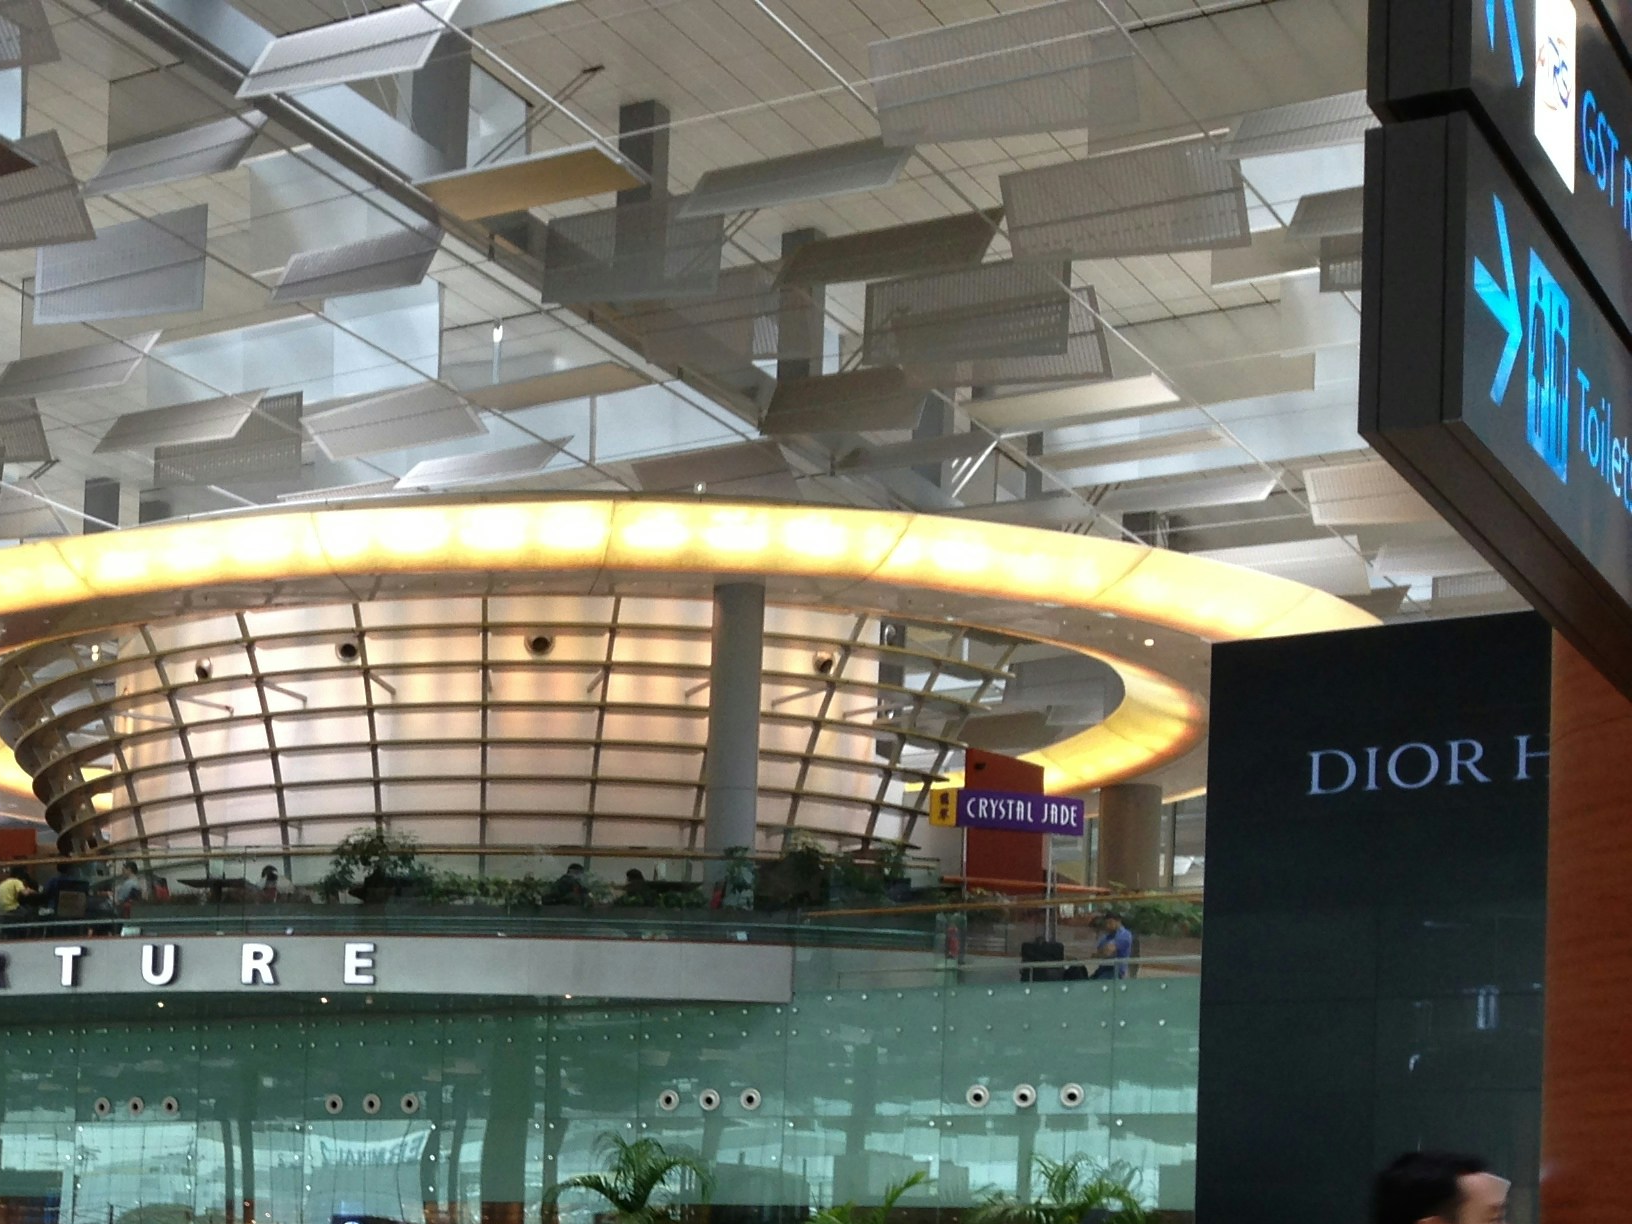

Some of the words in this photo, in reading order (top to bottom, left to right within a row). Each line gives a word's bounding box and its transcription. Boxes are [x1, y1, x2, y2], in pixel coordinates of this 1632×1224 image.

[1582, 89, 1619, 207] GST
[1576, 367, 1632, 514] Toilet
[1306, 738, 1493, 795] DIOR
[966, 797, 1034, 823] CRYSTAL
[1041, 803, 1078, 827] JADE
